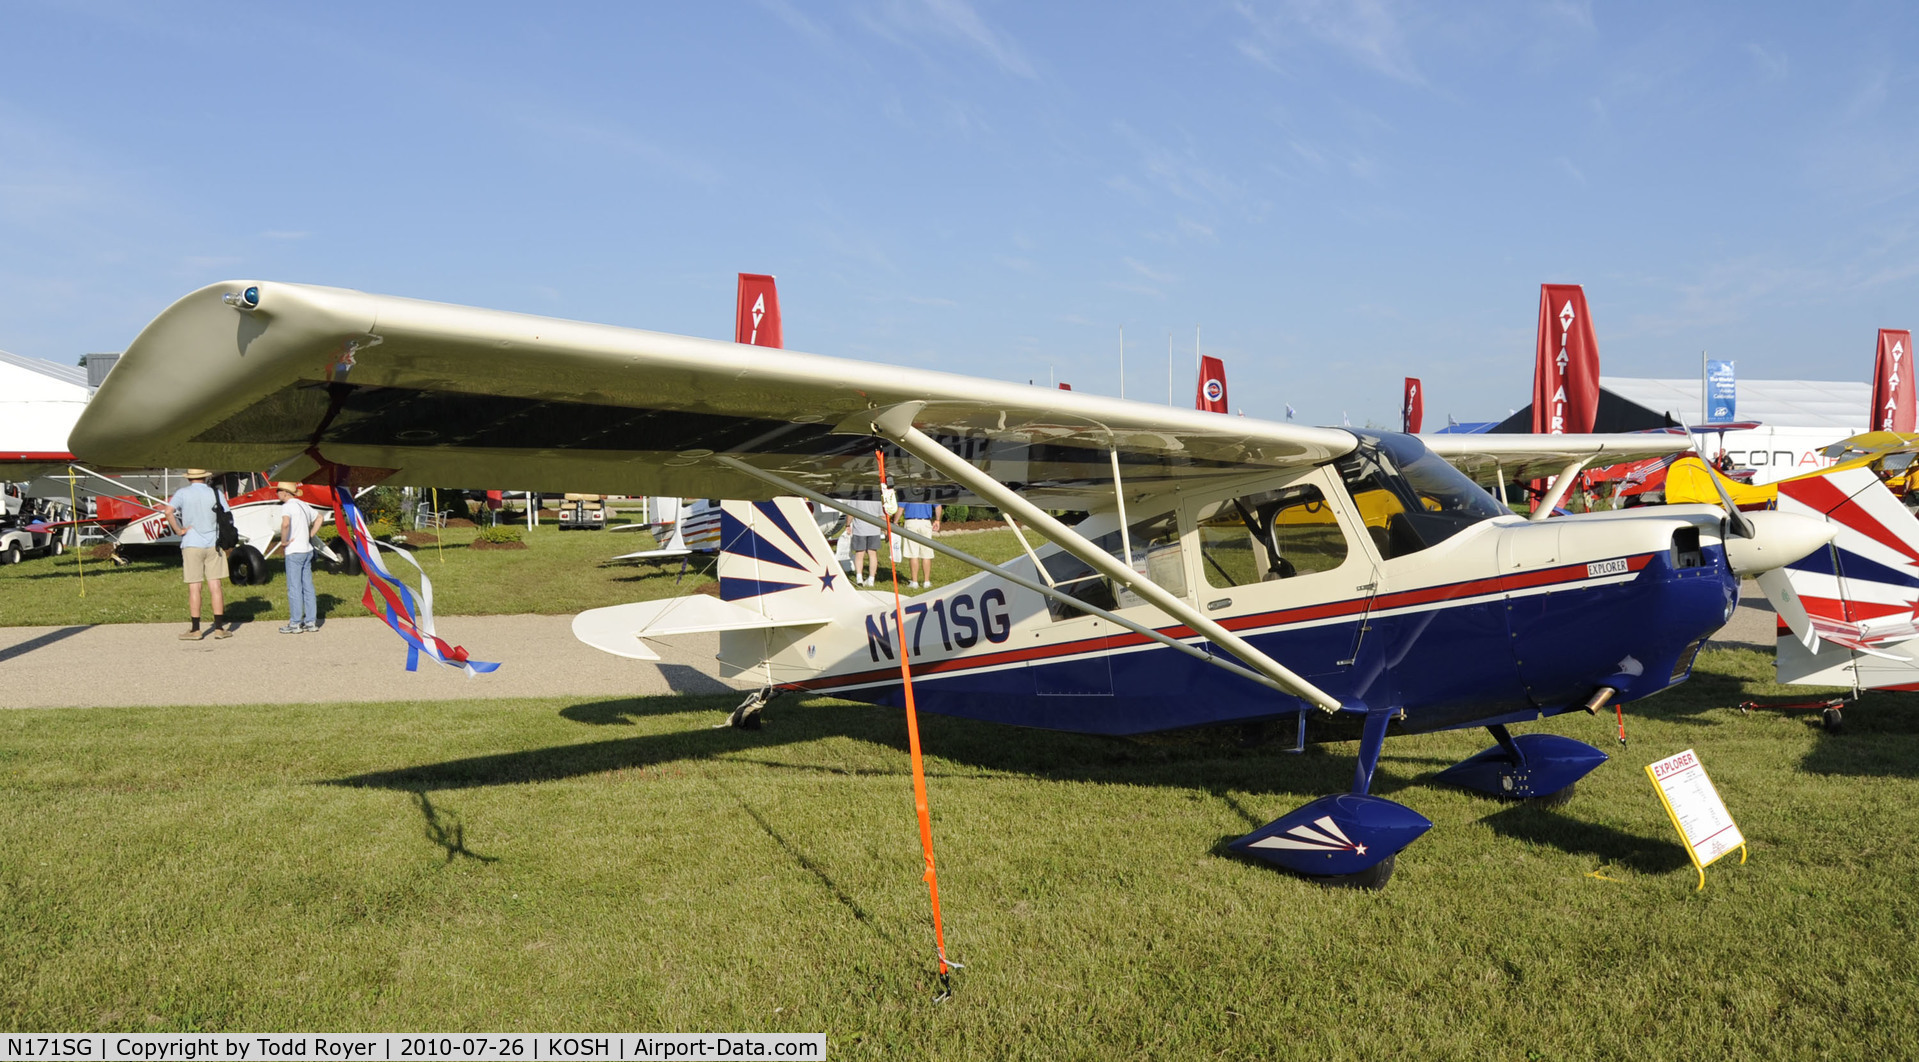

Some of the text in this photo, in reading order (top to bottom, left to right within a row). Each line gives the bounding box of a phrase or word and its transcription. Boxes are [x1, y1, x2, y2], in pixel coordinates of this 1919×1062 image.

[1555, 299, 1576, 376] AVIAT
[1887, 340, 1904, 392] AVIAT
[1588, 560, 1627, 576] EXPLORER
[865, 588, 1011, 662] N171SG
[1654, 753, 1694, 777] EXPLORER
